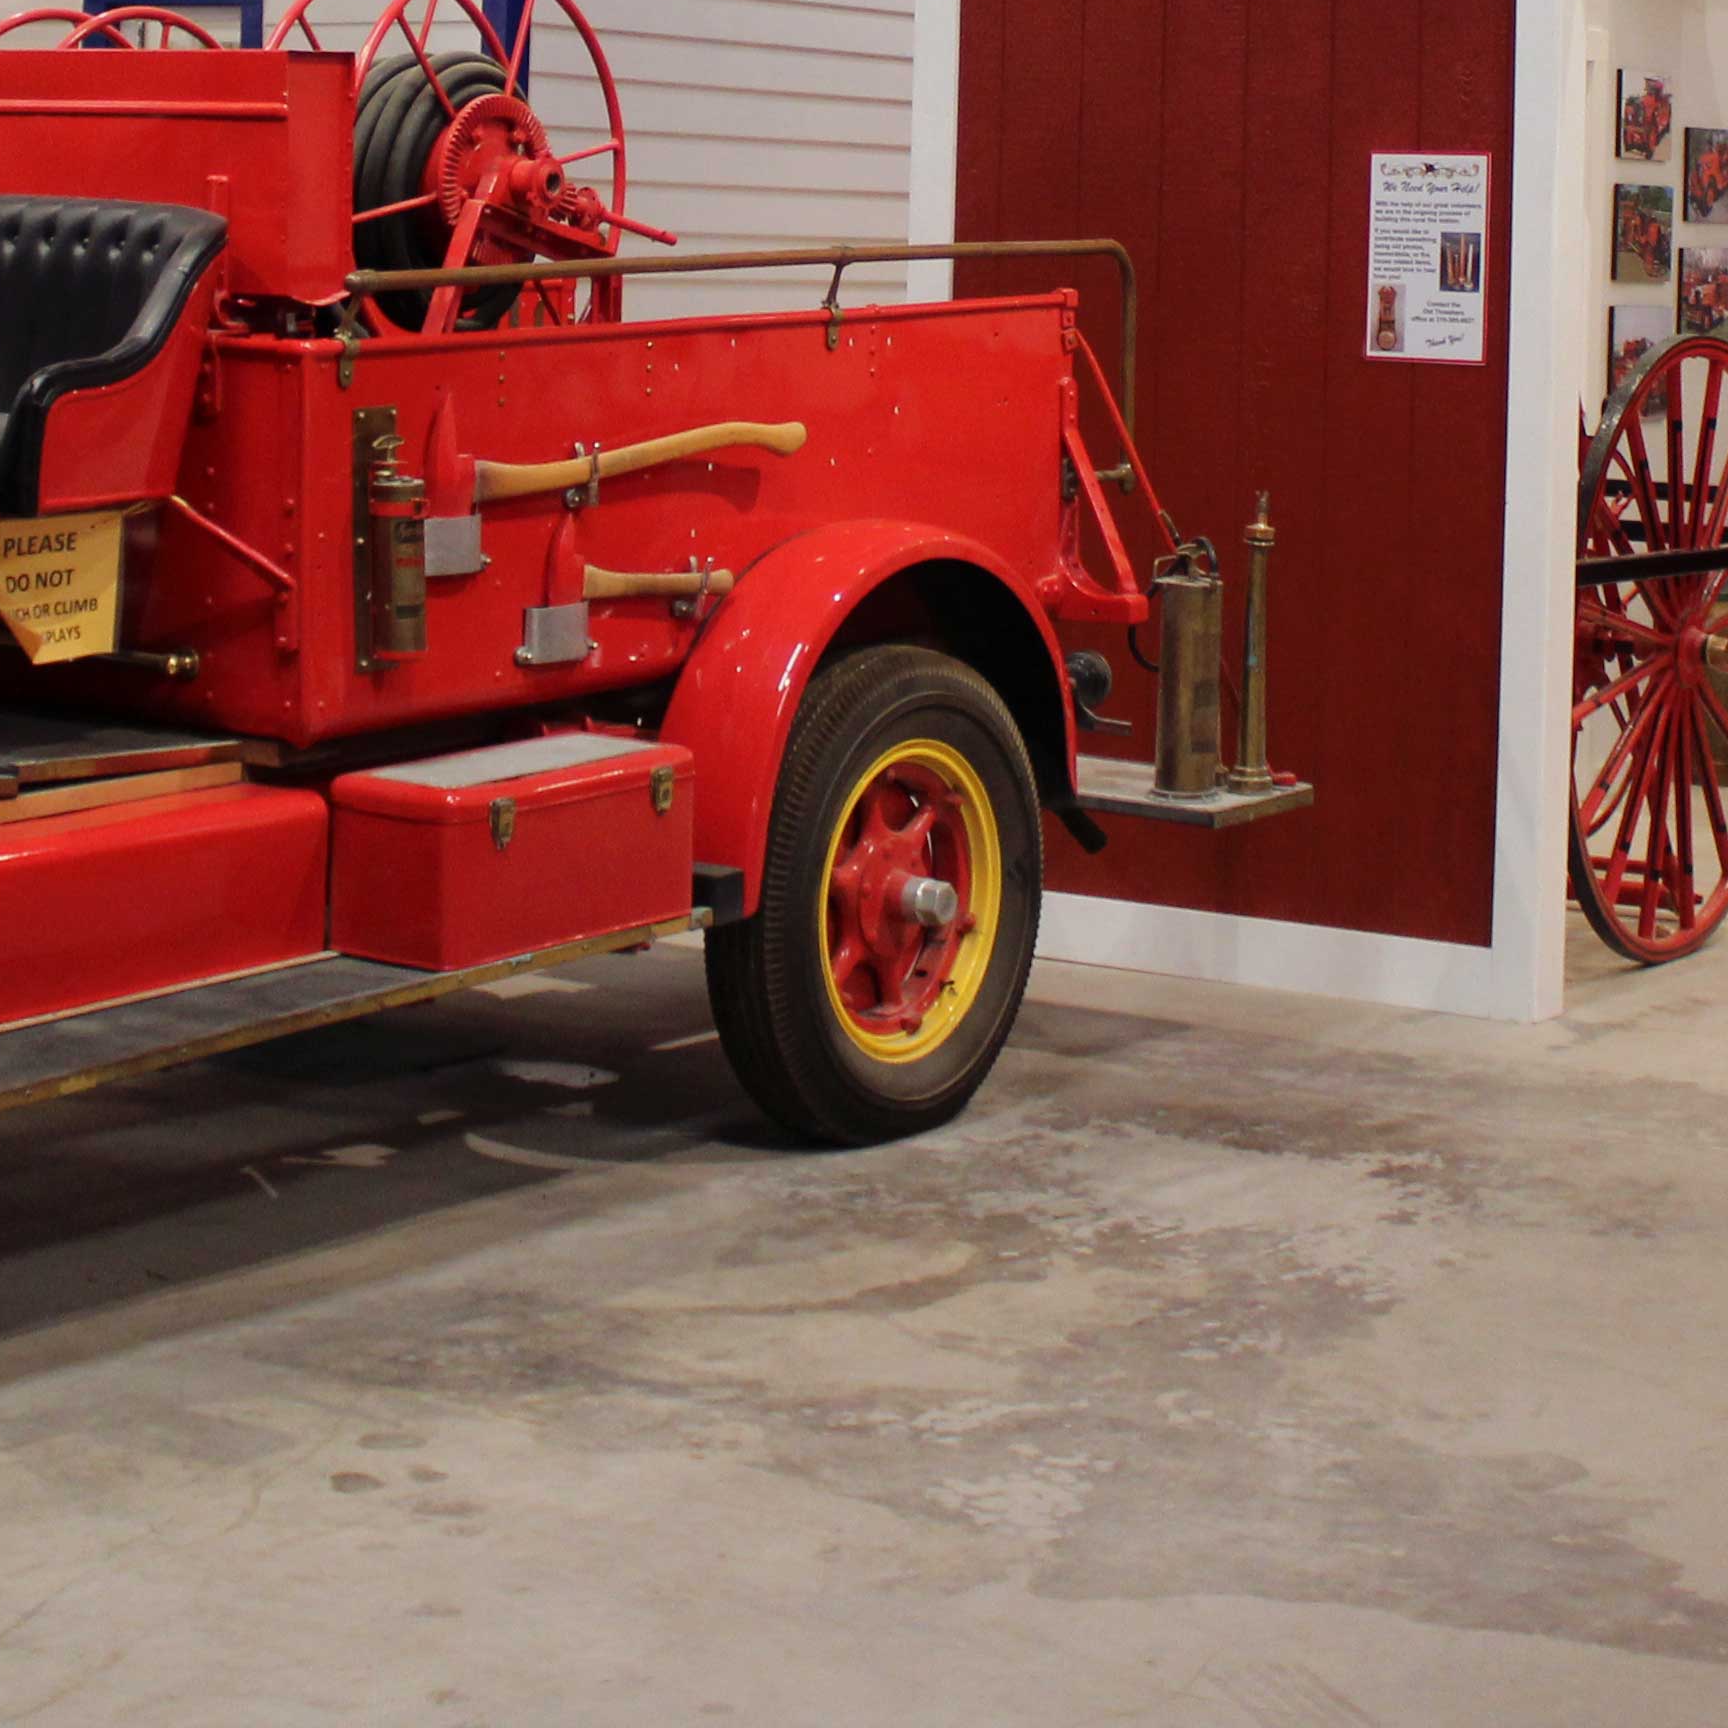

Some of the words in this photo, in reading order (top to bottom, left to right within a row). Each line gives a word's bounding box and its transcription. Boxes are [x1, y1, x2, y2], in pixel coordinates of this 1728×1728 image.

[3, 532, 77, 558] PLEASE
[5, 575, 30, 593] DO
[36, 569, 75, 589] NOT
[33, 603, 51, 618] OR
[53, 598, 98, 616] CLIMB
